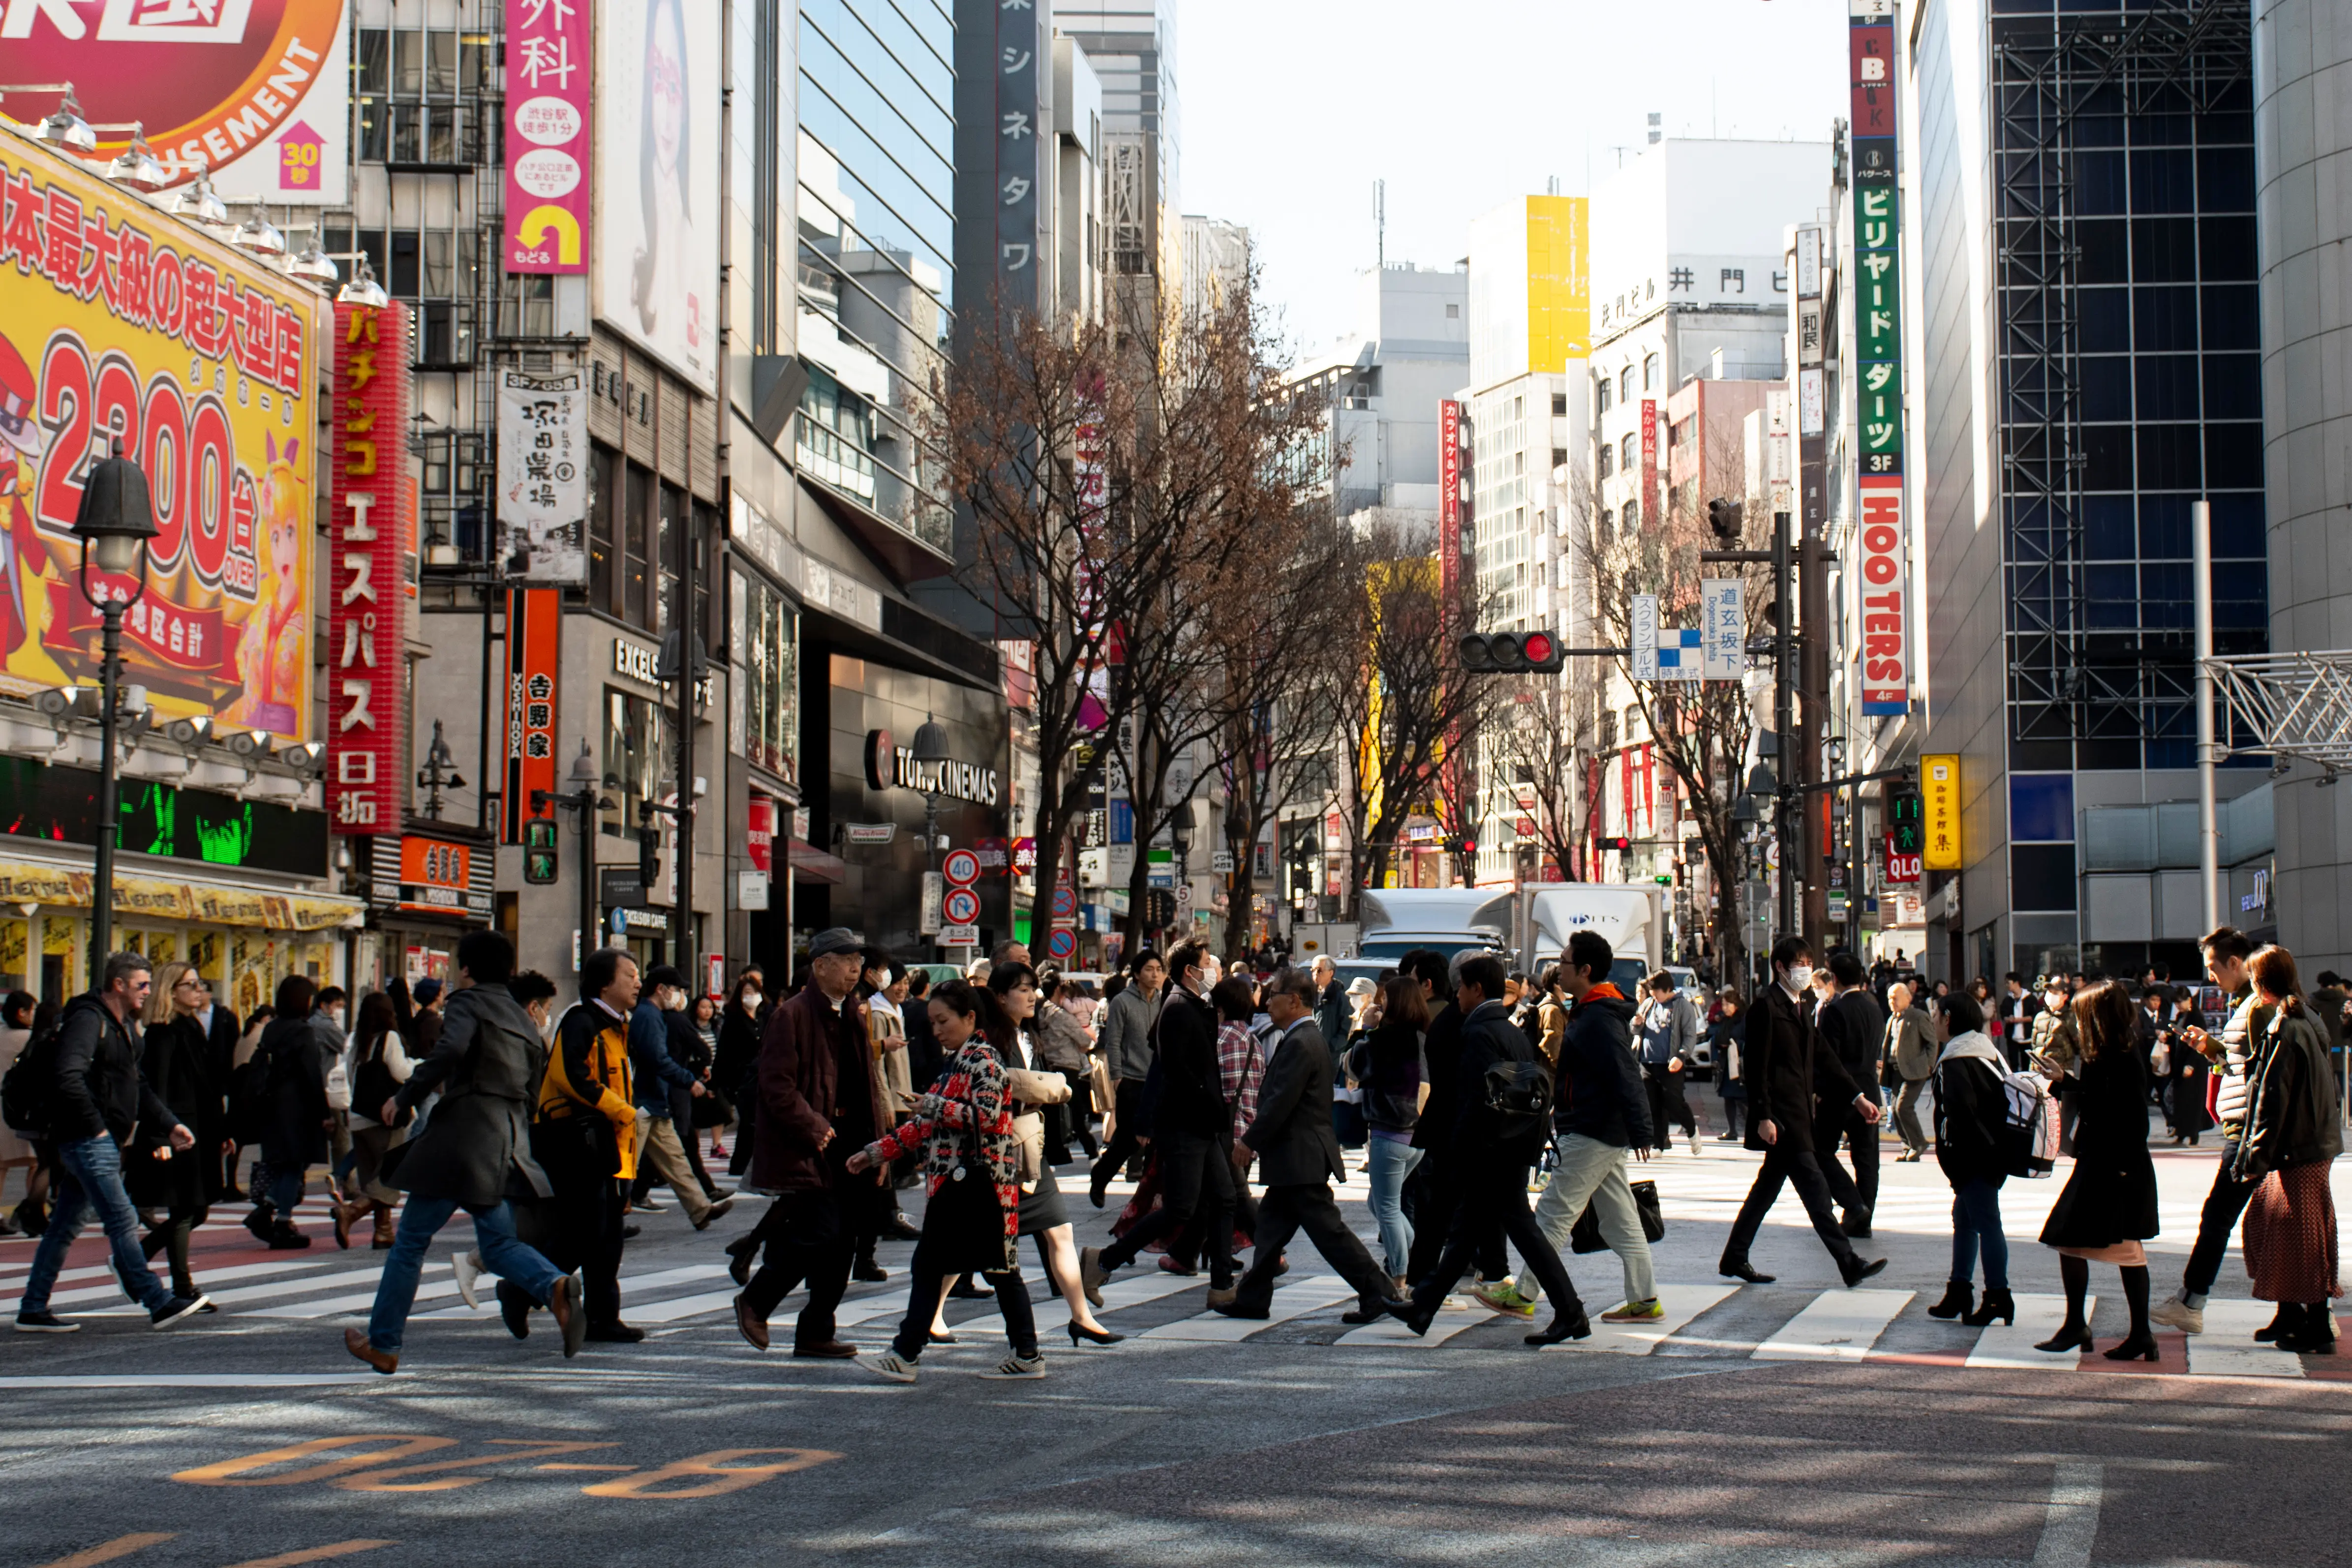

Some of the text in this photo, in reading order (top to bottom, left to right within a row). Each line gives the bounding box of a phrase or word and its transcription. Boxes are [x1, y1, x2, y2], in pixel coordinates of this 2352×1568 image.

[528, 106, 568, 121] 渋谷駅
[522, 122, 573, 135] 徒歩1分
[282, 143, 318, 167] 30
[514, 251, 550, 264] もどる
[0, 172, 302, 400] 本最大級の超大型店
[1602, 277, 1655, 328] 井門ビル
[1802, 314, 1817, 348] 和民
[1863, 190, 1894, 449] ビリヤード・ダーツ
[1870, 455, 1892, 472] 3F
[224, 556, 256, 589] OVER
[1863, 496, 1902, 682] HOOTERS
[1637, 599, 1652, 677] スクランブル式
[1720, 588, 1738, 671] 道玄坂下
[1661, 667, 1700, 680] 時差式
[1876, 691, 1894, 702] 4F
[511, 673, 523, 758] YOSHINOYA
[527, 673, 553, 759] 吉野家
[937, 759, 997, 806] CINEMAS
[953, 861, 972, 876] 40
[1179, 888, 1188, 899] 5
[1309, 898, 1314, 907] 7
[1592, 915, 1619, 923] ITS
